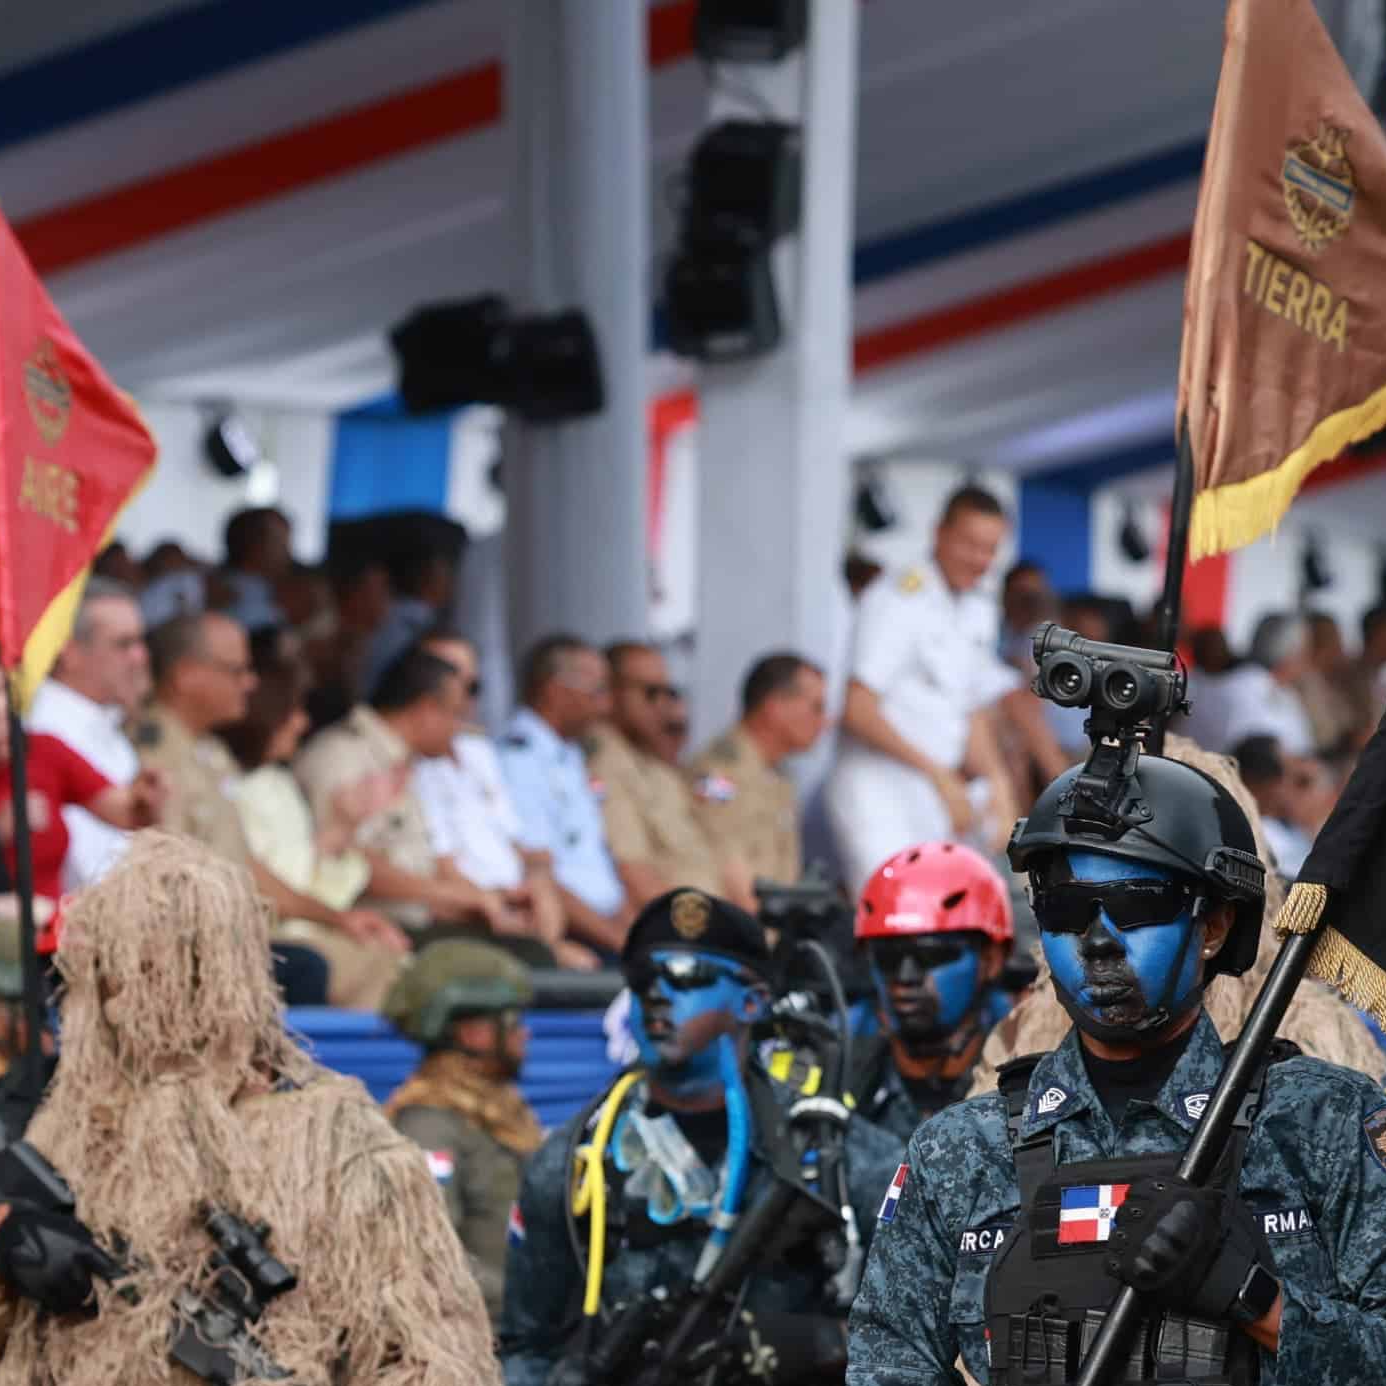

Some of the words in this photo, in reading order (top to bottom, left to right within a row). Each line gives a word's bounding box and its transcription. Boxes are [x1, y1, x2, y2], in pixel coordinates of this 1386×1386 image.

[1243, 239, 1350, 353] TIERRA
[1253, 1209, 1314, 1233] RMA
[960, 1229, 1004, 1251] RCA
